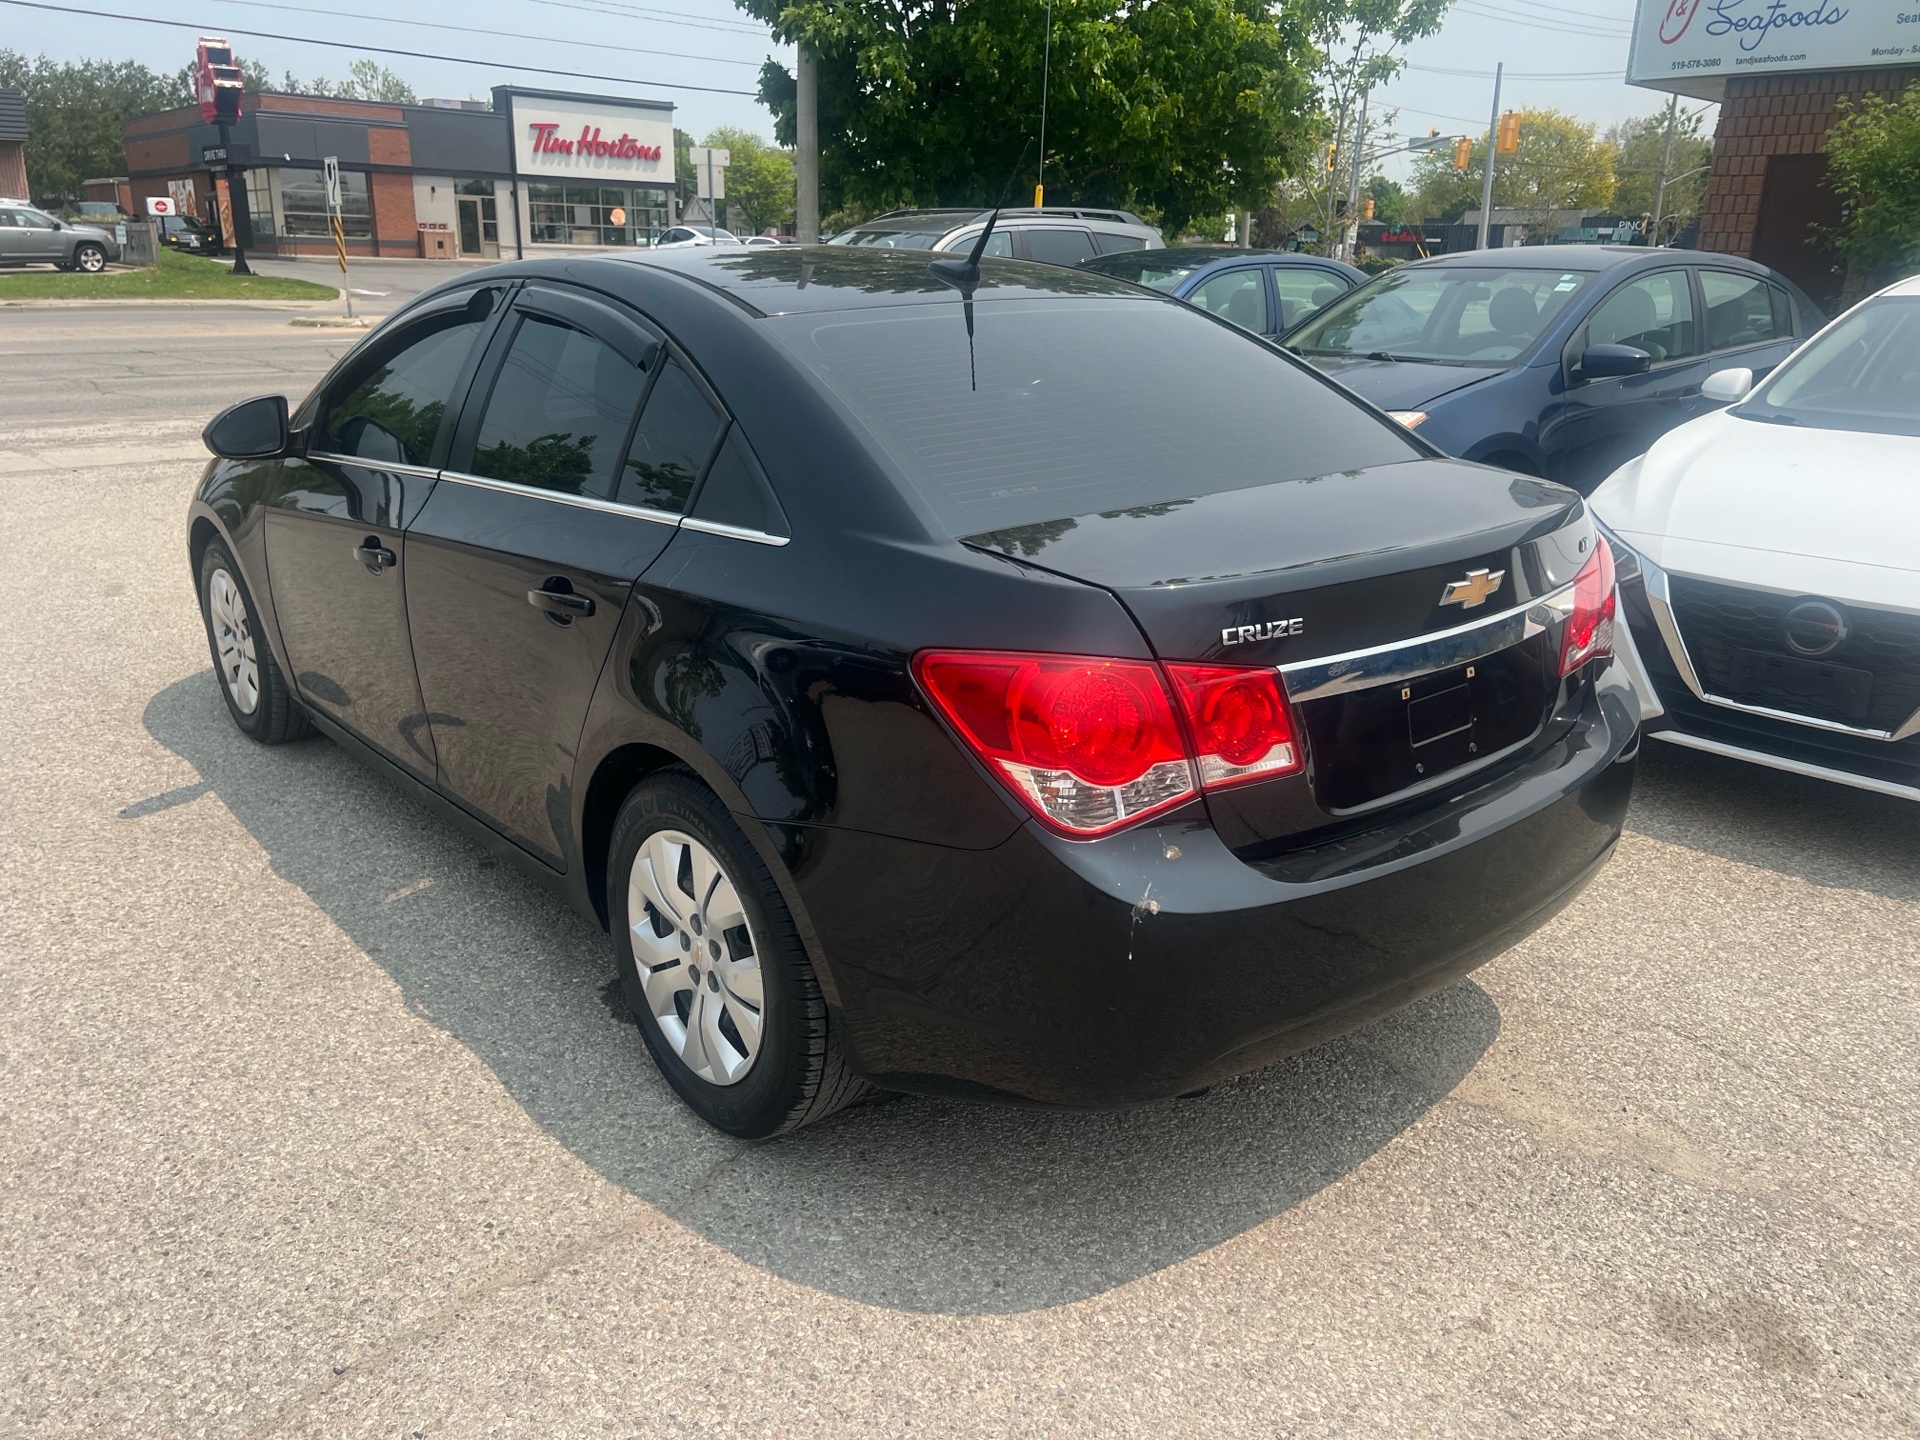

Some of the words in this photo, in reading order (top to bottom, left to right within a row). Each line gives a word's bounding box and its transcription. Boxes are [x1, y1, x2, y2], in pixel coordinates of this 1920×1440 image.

[1706, 0, 1849, 51] Seafoods
[1671, 58, 1721, 70] 519-578-3080
[1735, 53, 1807, 66] tandjseafoods.com
[1871, 46, 1905, 56] Monday
[529, 123, 574, 155] Tim
[577, 124, 662, 161] Hortons
[1221, 617, 1304, 646] CRUZE
[665, 801, 715, 841] ALTIMAX
